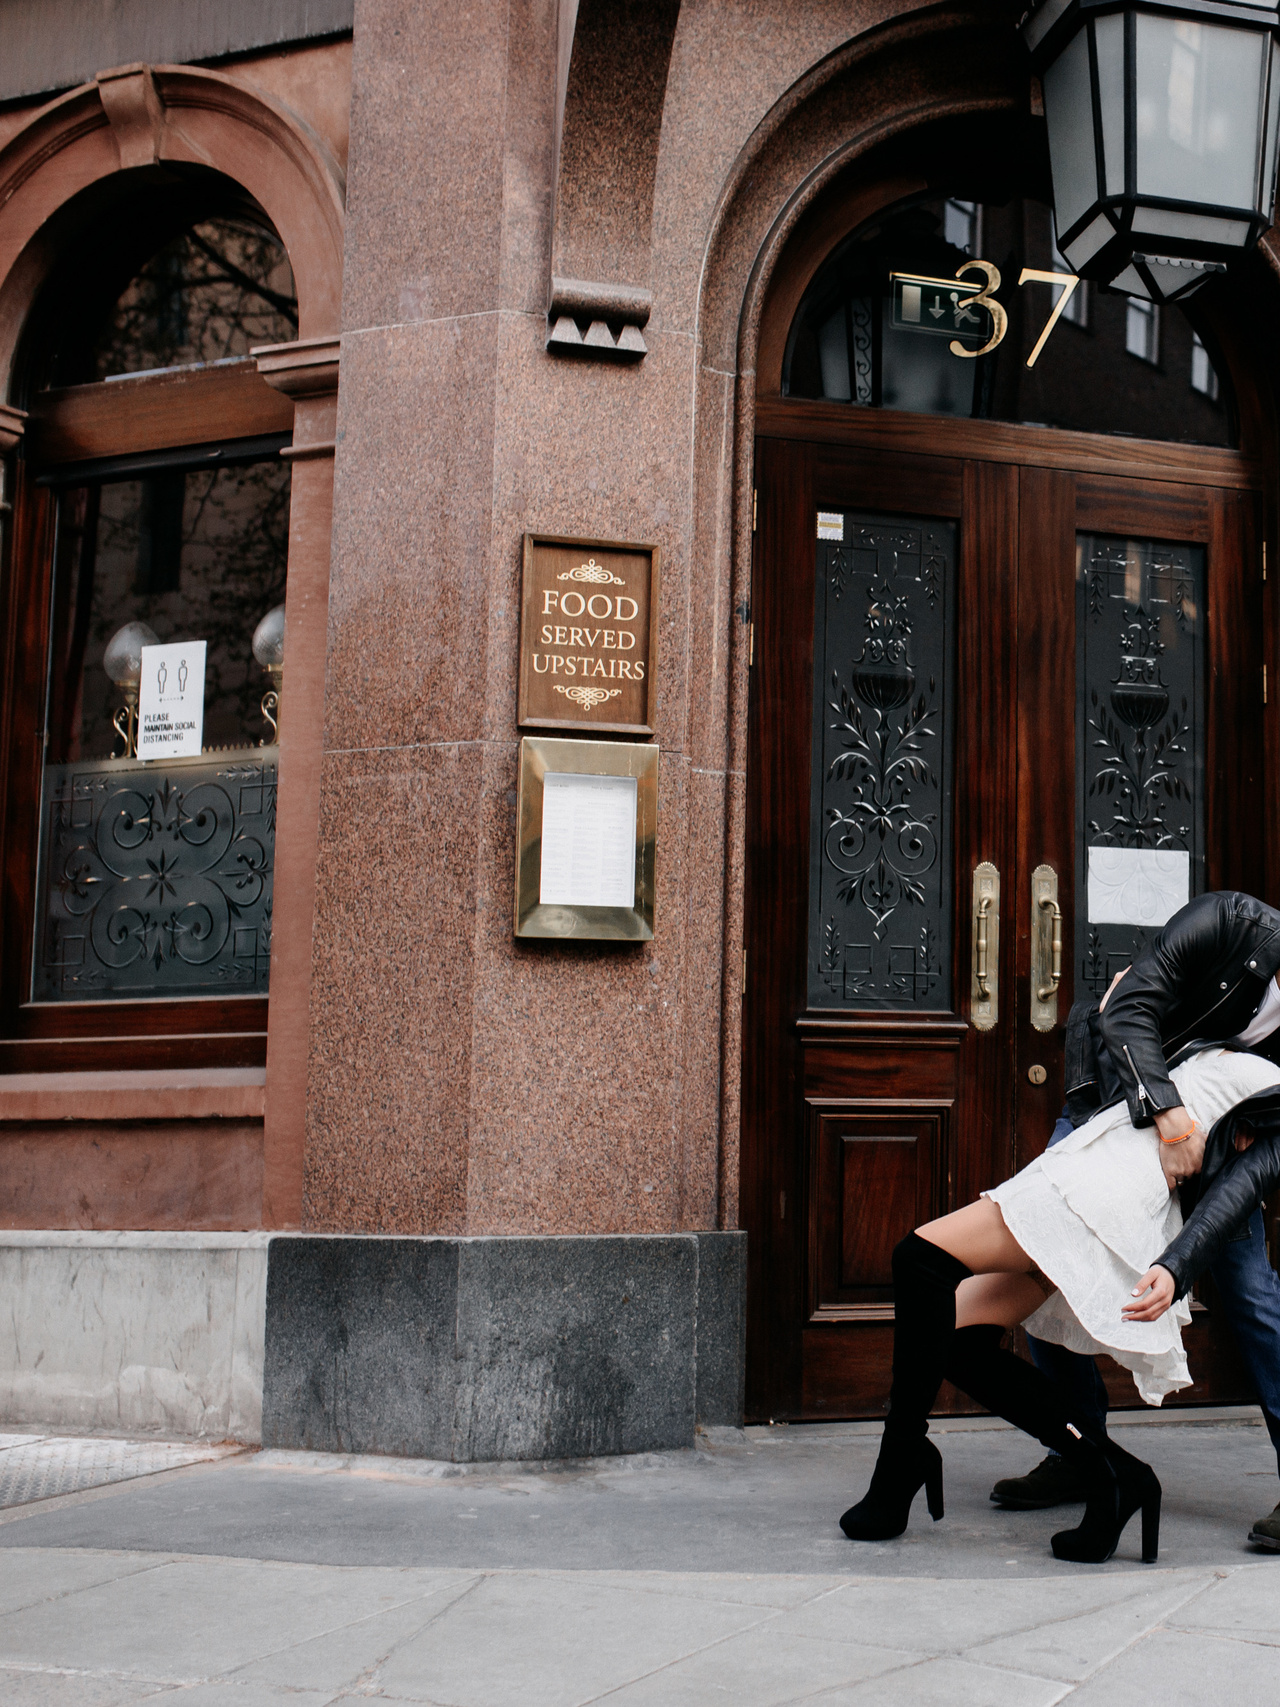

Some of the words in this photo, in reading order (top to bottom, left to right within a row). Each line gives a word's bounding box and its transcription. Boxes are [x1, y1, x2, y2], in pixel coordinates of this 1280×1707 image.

[949, 259, 1080, 368] 37
[541, 589, 639, 621] FOOD
[540, 624, 636, 650] SERVED
[532, 653, 645, 680] UPSTAIRS
[143, 723, 174, 732] MAINTAIN
[174, 720, 196, 731] SOCIAL
[144, 712, 169, 722] PLEASE
[143, 732, 184, 744] DISTANCING
